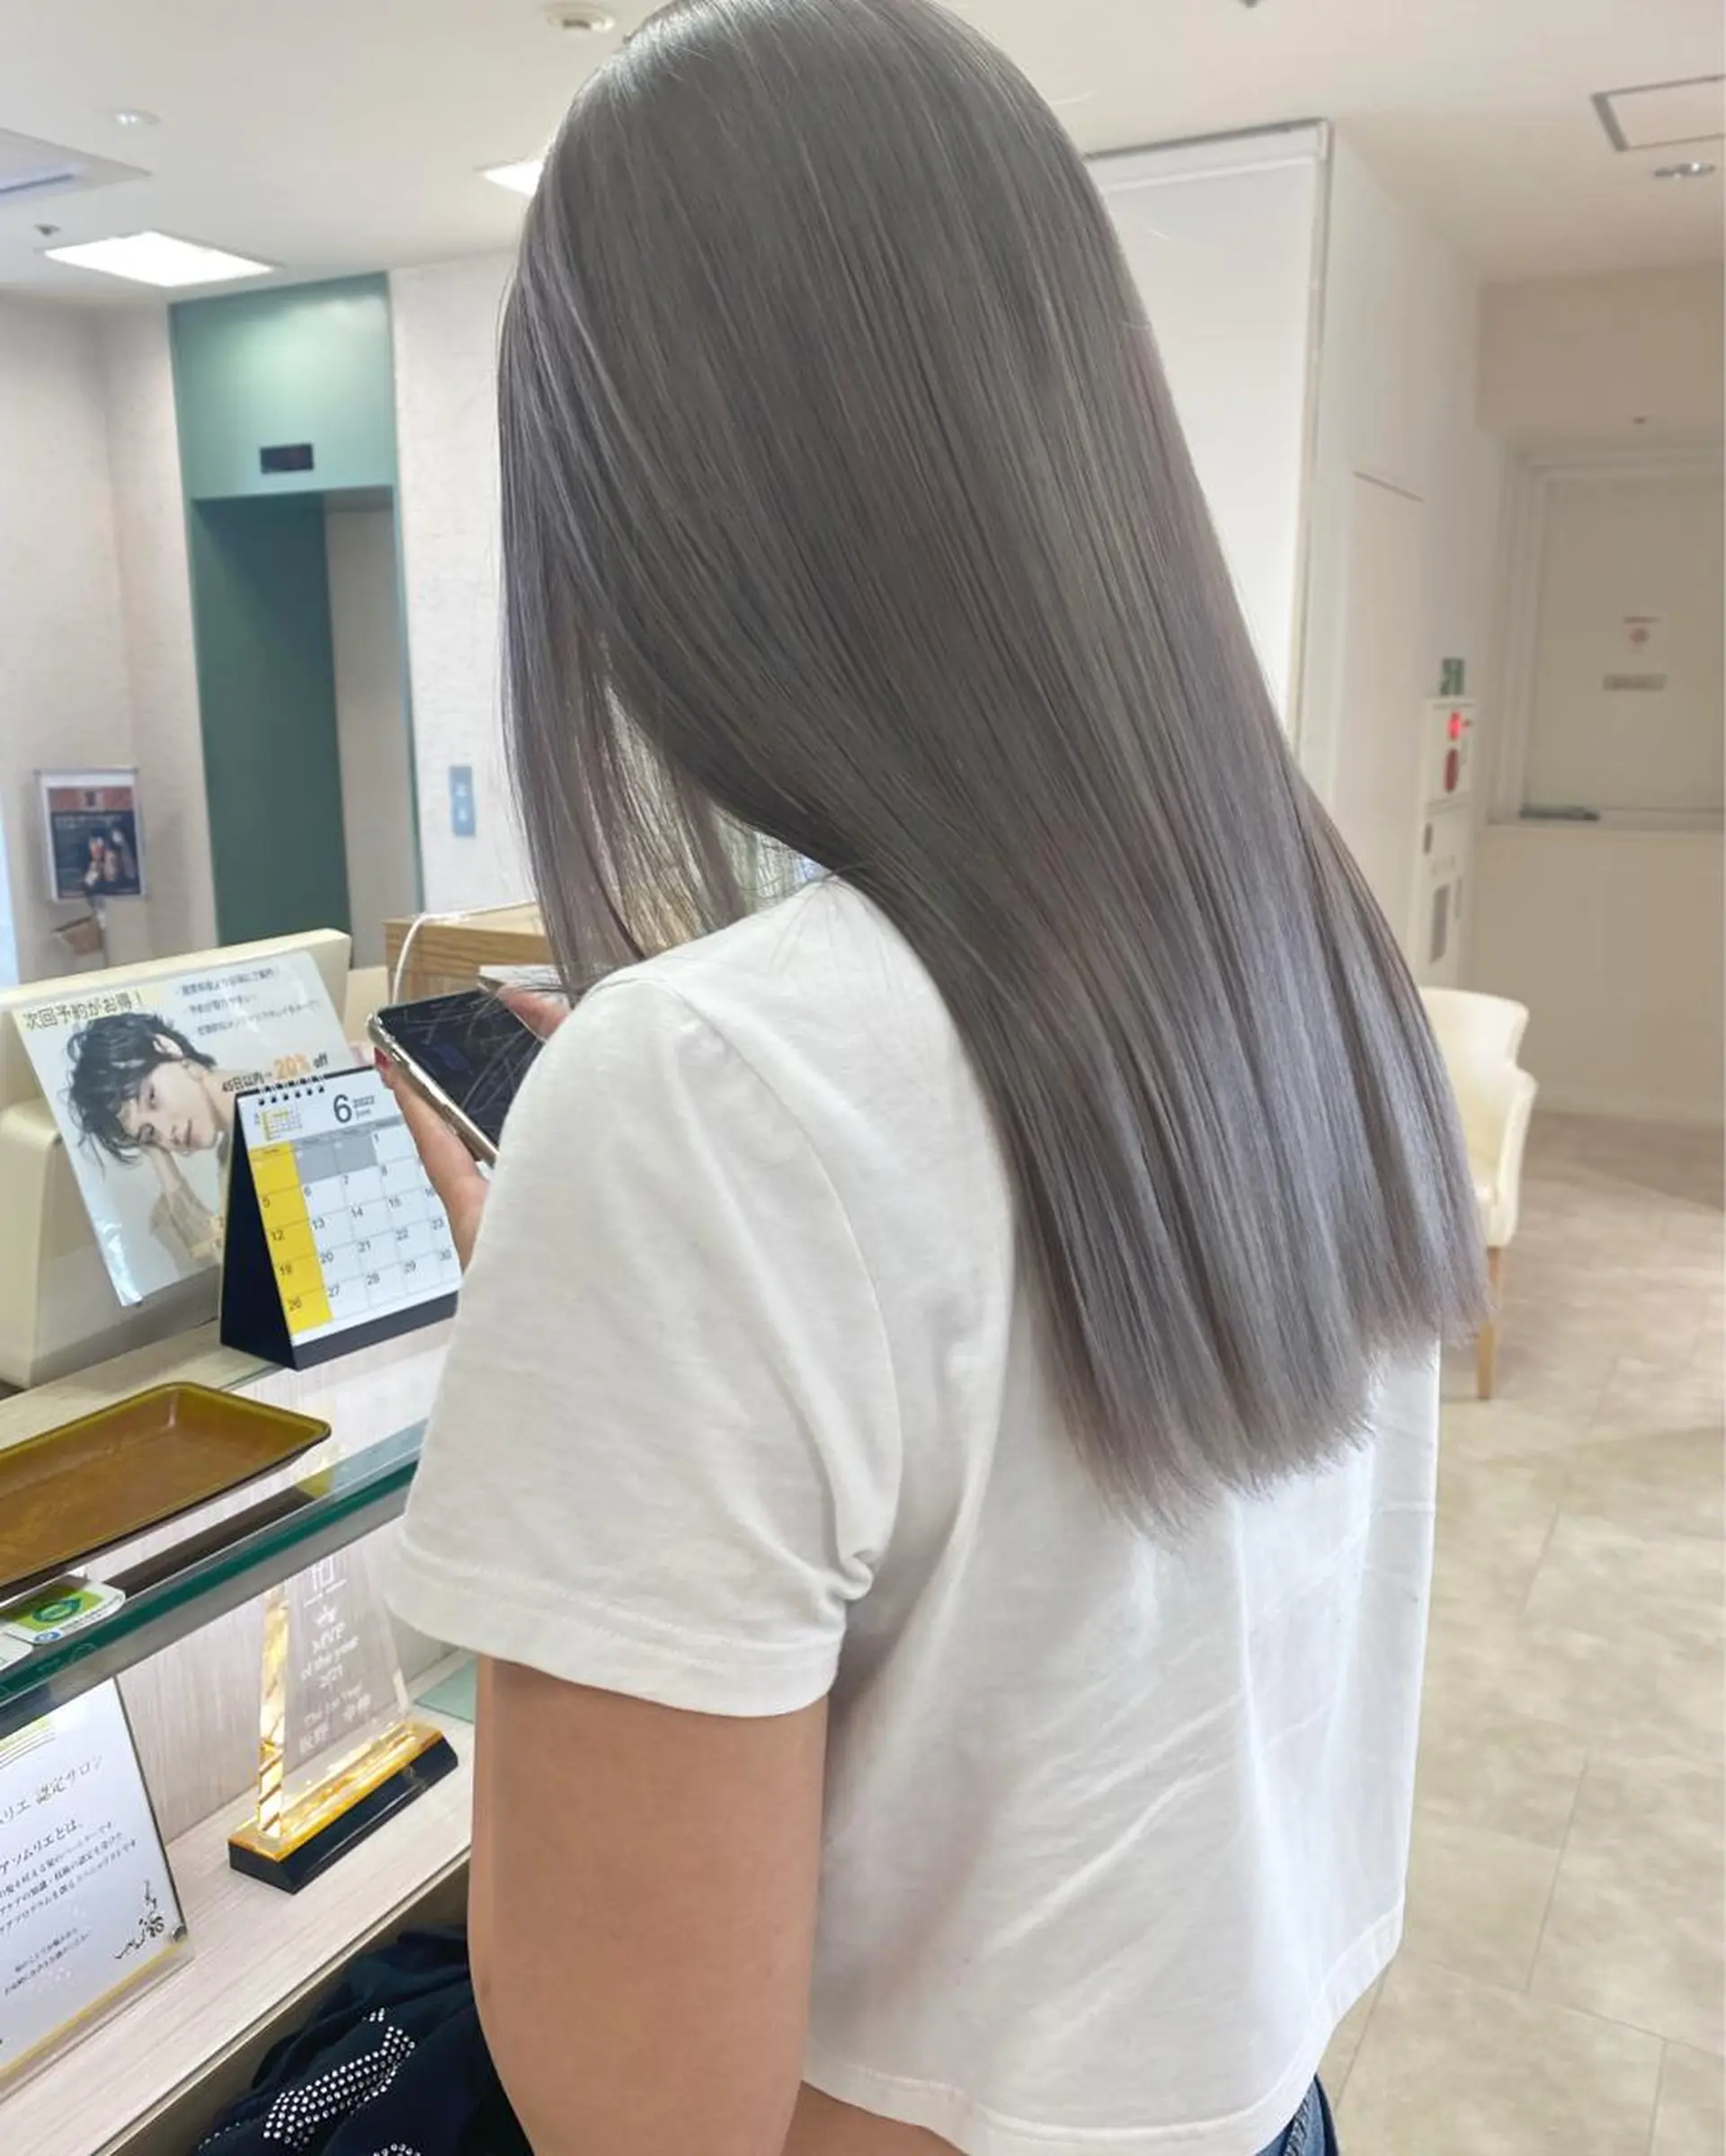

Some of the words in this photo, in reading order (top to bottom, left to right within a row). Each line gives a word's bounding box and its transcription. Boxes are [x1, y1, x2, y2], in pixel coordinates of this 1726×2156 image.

[334, 1094, 352, 1123] 6
[352, 1096, 375, 1108] 2022
[262, 1195, 271, 1209] 5
[343, 1174, 350, 1185] 7
[271, 1229, 285, 1241] 12
[312, 1217, 325, 1229] 13
[351, 1207, 364, 1219] 14
[388, 1197, 402, 1209] 15
[280, 1263, 292, 1275] 19
[320, 1250, 334, 1264] 20
[359, 1239, 371, 1253] 21
[396, 1228, 409, 1241] 22
[432, 1218, 444, 1230] 23
[288, 1296, 302, 1310] 26
[328, 1284, 340, 1298] 27
[367, 1273, 380, 1286] 28
[405, 1259, 417, 1273] 29
